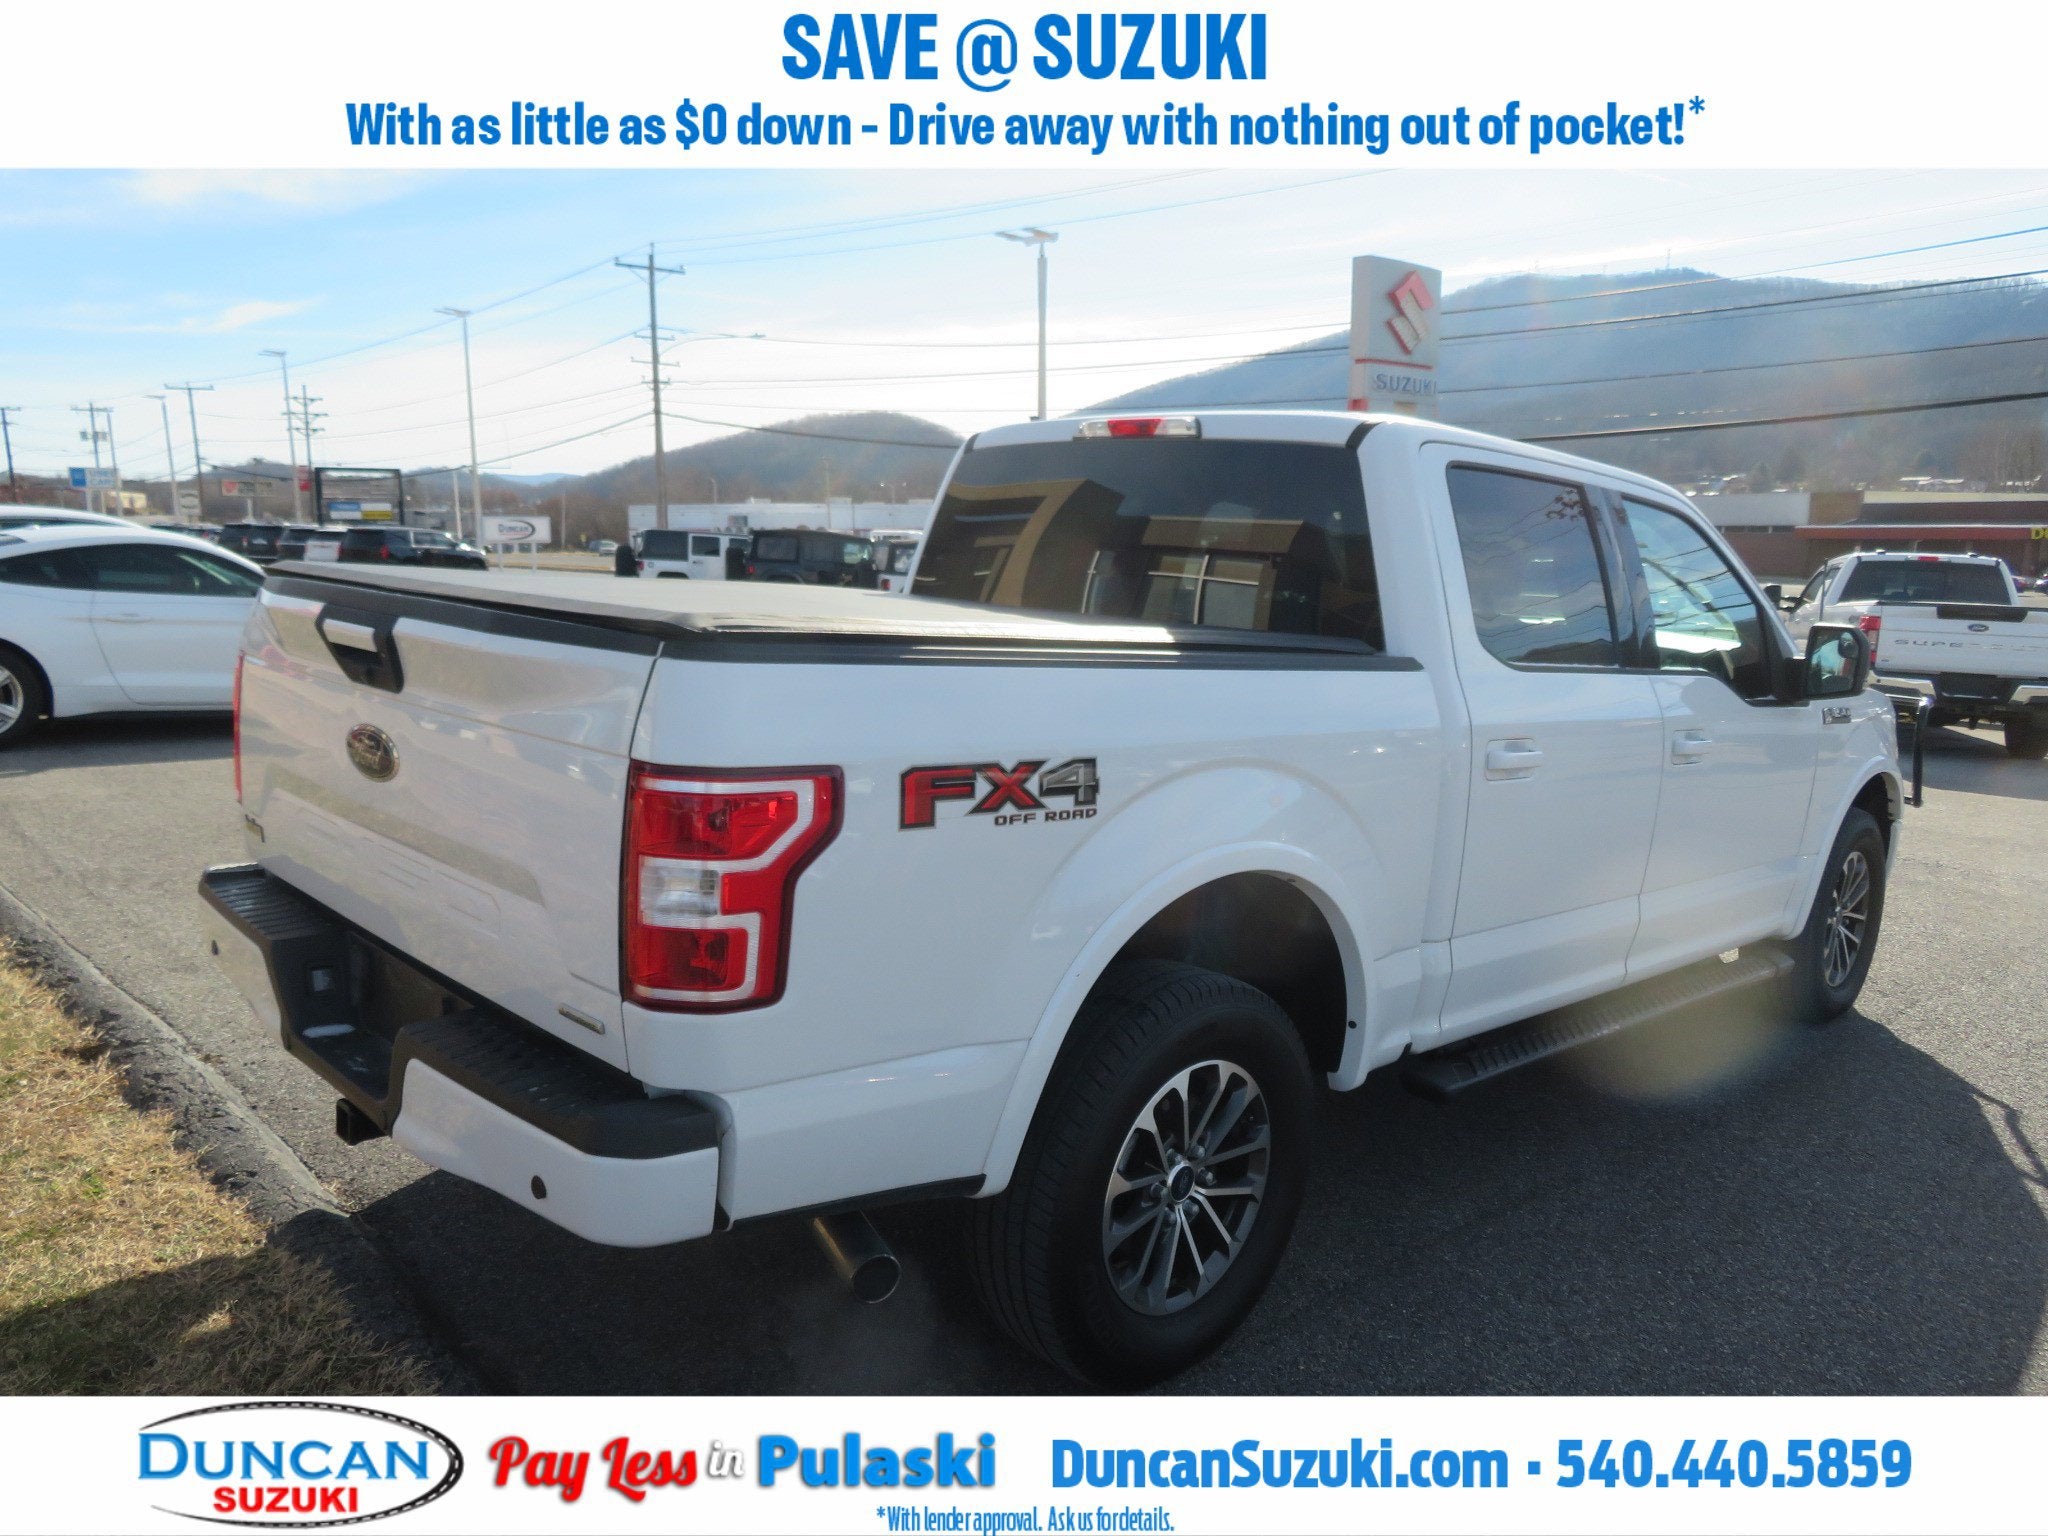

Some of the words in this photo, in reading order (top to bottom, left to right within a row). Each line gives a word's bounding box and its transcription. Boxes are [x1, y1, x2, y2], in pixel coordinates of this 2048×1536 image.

[1376, 373, 1437, 395] SUZUKI
[899, 757, 1099, 831] FX4
[994, 812, 1036, 827] OFF
[1045, 808, 1098, 823] ROAD
